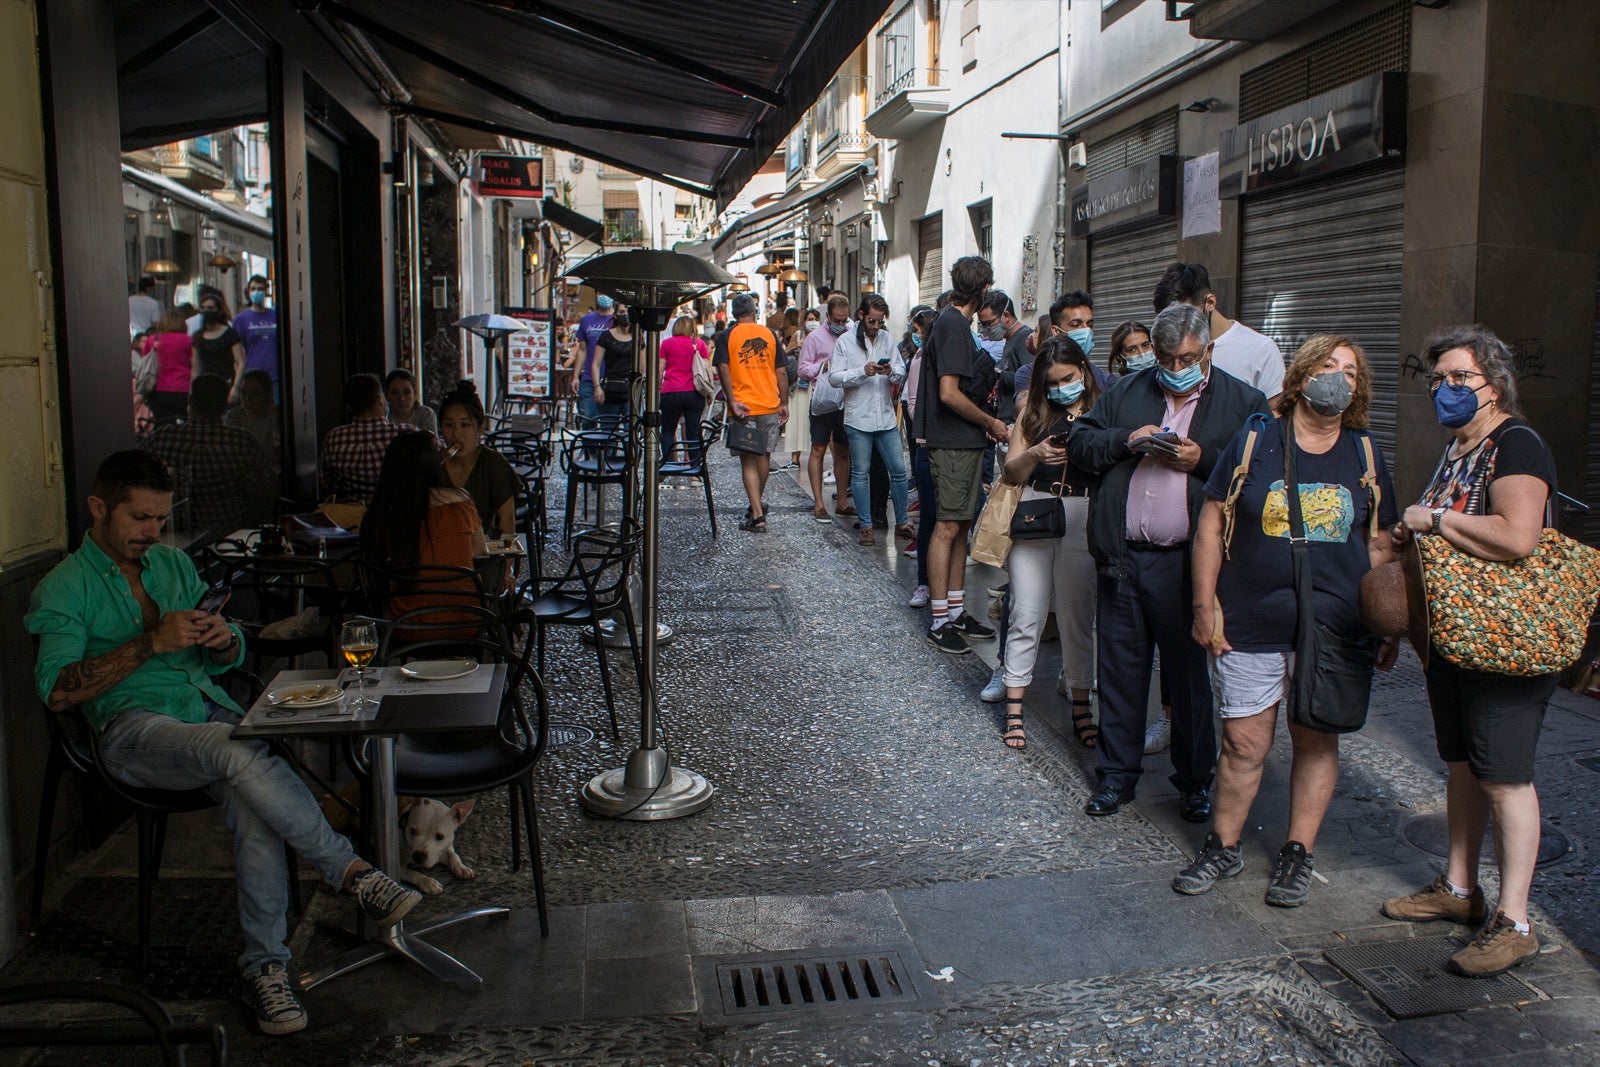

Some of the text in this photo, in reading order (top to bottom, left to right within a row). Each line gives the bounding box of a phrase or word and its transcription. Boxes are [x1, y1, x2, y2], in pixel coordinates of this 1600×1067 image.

[1248, 110, 1342, 176] LISBOA
[481, 159, 510, 169] SNACK
[1122, 178, 1155, 208] POLLOS
